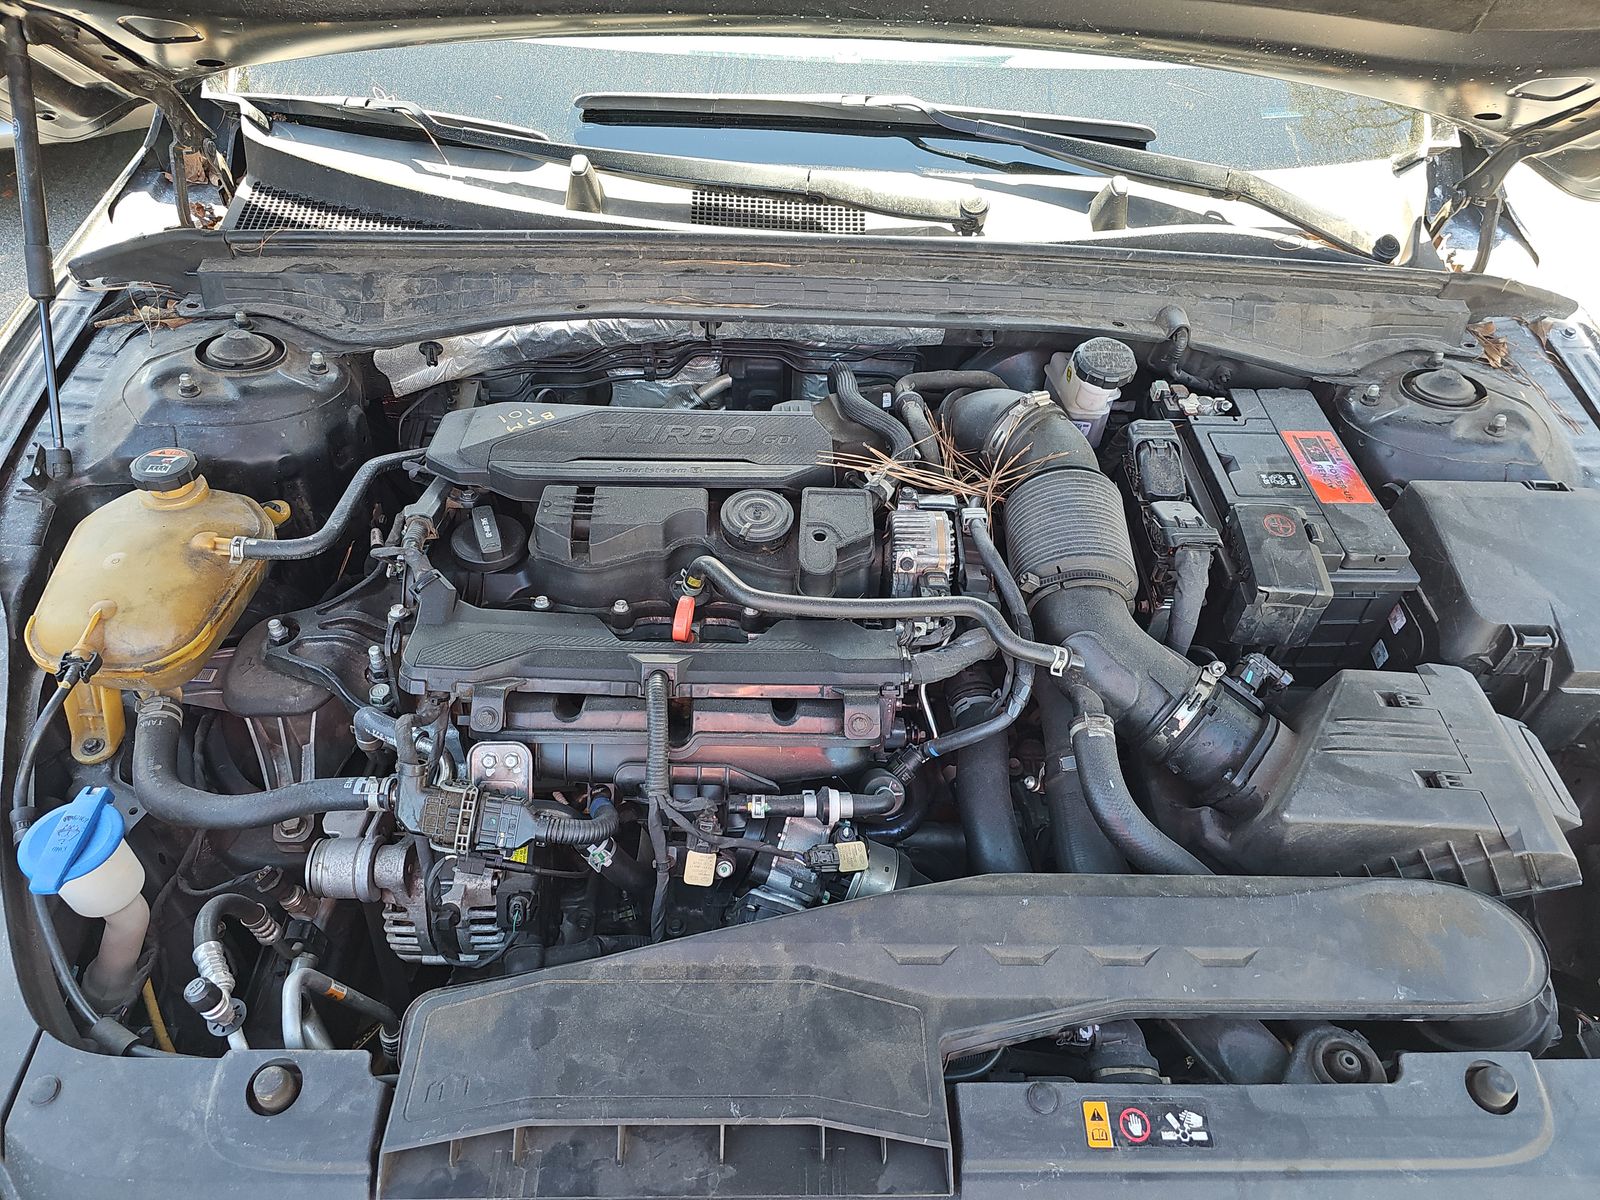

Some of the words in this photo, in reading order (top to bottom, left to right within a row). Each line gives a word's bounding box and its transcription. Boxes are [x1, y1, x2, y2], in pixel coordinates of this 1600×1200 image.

[600, 423, 757, 446] TURBO
[615, 466, 688, 474] Smartstream
[139, 719, 162, 729] TANK
